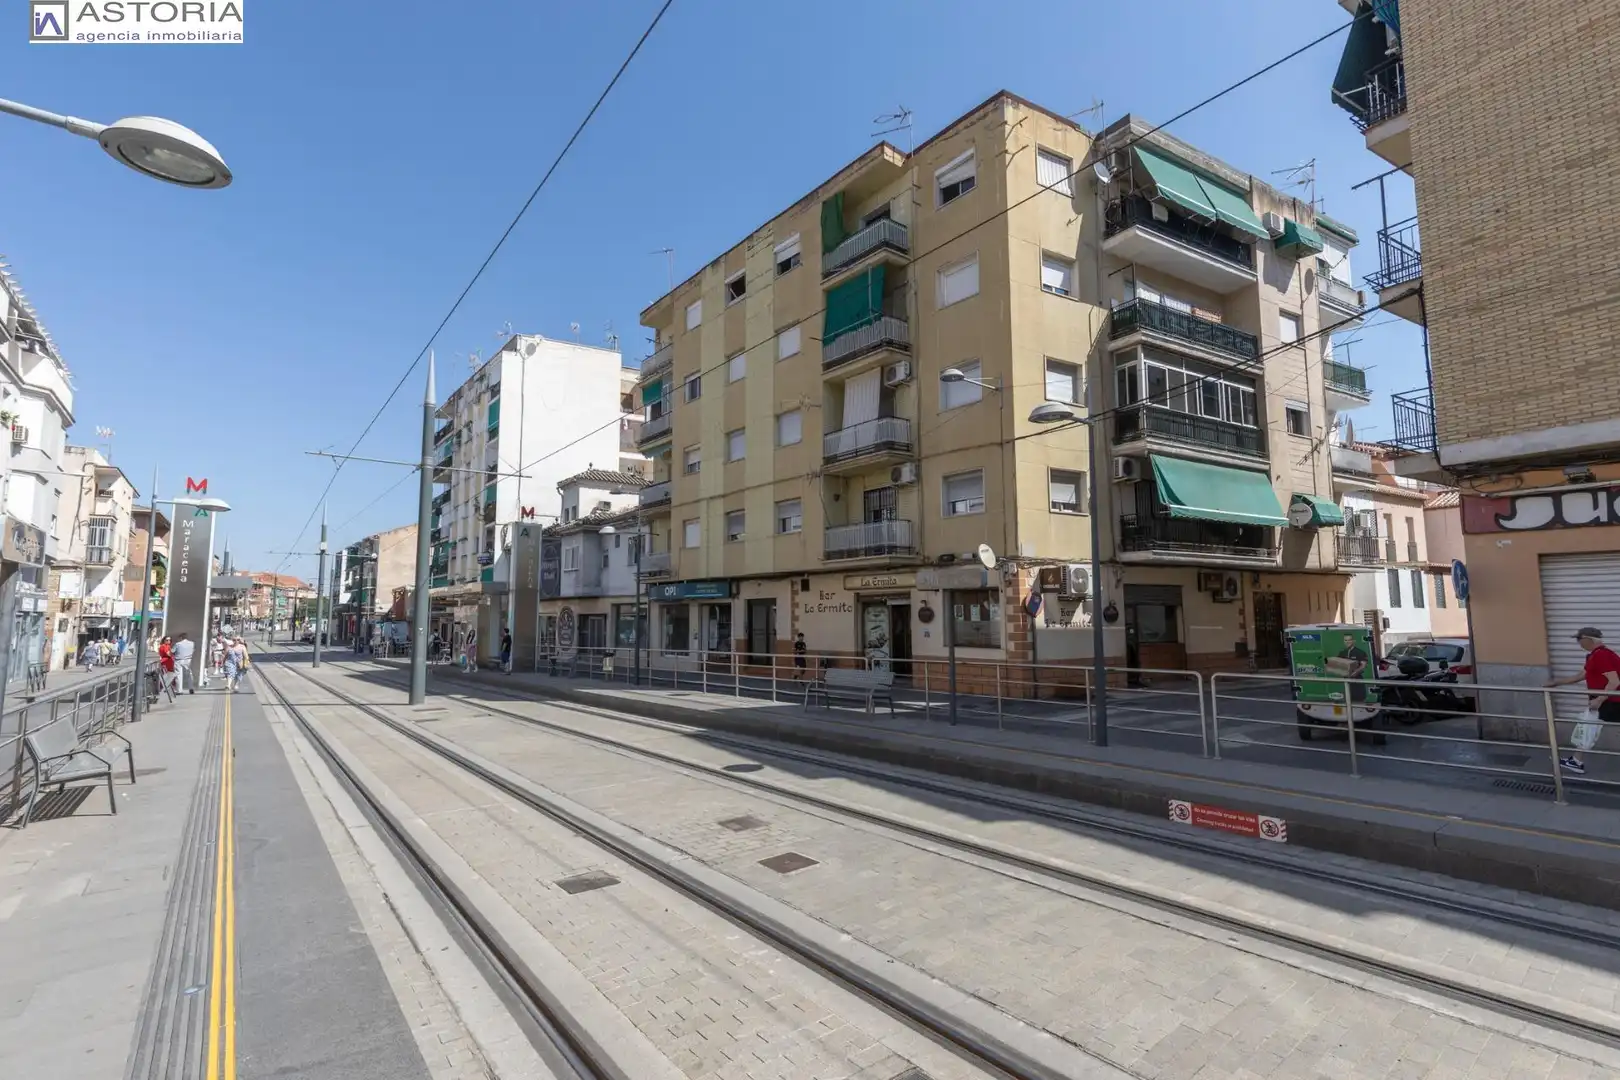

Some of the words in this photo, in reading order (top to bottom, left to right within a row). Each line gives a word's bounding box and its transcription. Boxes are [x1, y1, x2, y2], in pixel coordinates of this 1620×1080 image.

[180, 519, 194, 583] Maracena
[860, 577, 872, 587] La
[872, 576, 897, 587] Ermita
[664, 586, 677, 596] OPI
[819, 590, 836, 601] Bar
[804, 603, 815, 614] La
[817, 602, 853, 614] Ermita
